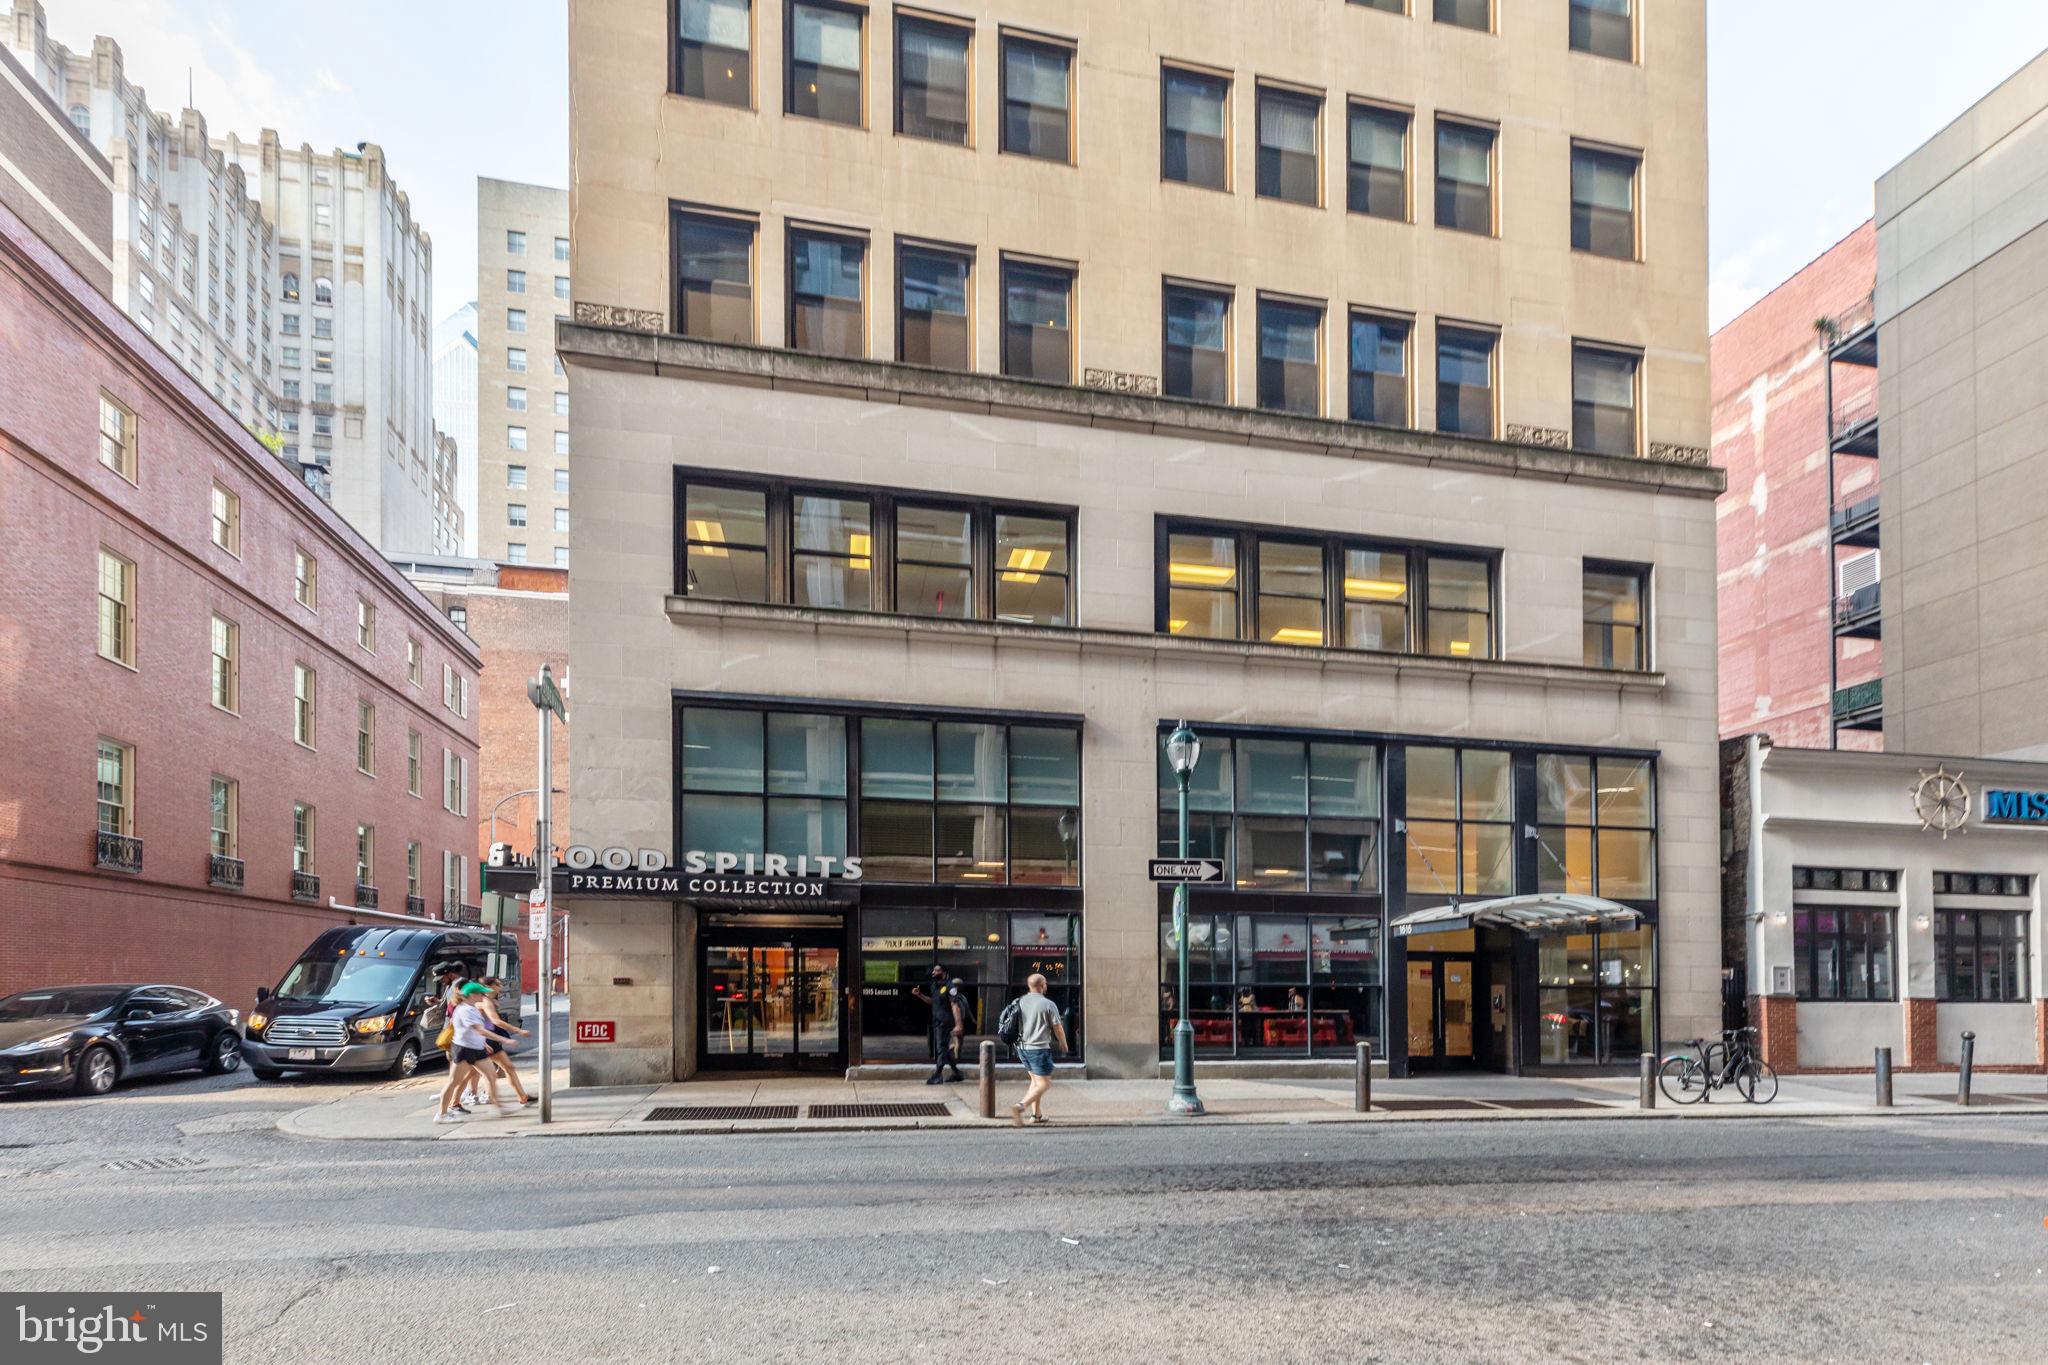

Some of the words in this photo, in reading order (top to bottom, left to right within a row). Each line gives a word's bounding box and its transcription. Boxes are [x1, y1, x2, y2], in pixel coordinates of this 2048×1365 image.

[1986, 790, 2048, 819] MIS
[685, 850, 863, 881] SPIRITS
[1156, 865, 1176, 876] ONE
[1180, 865, 1201, 876] WAY
[571, 874, 679, 892] PREMIUM
[689, 878, 824, 897] COLLECTION
[584, 1024, 608, 1037] FDC
